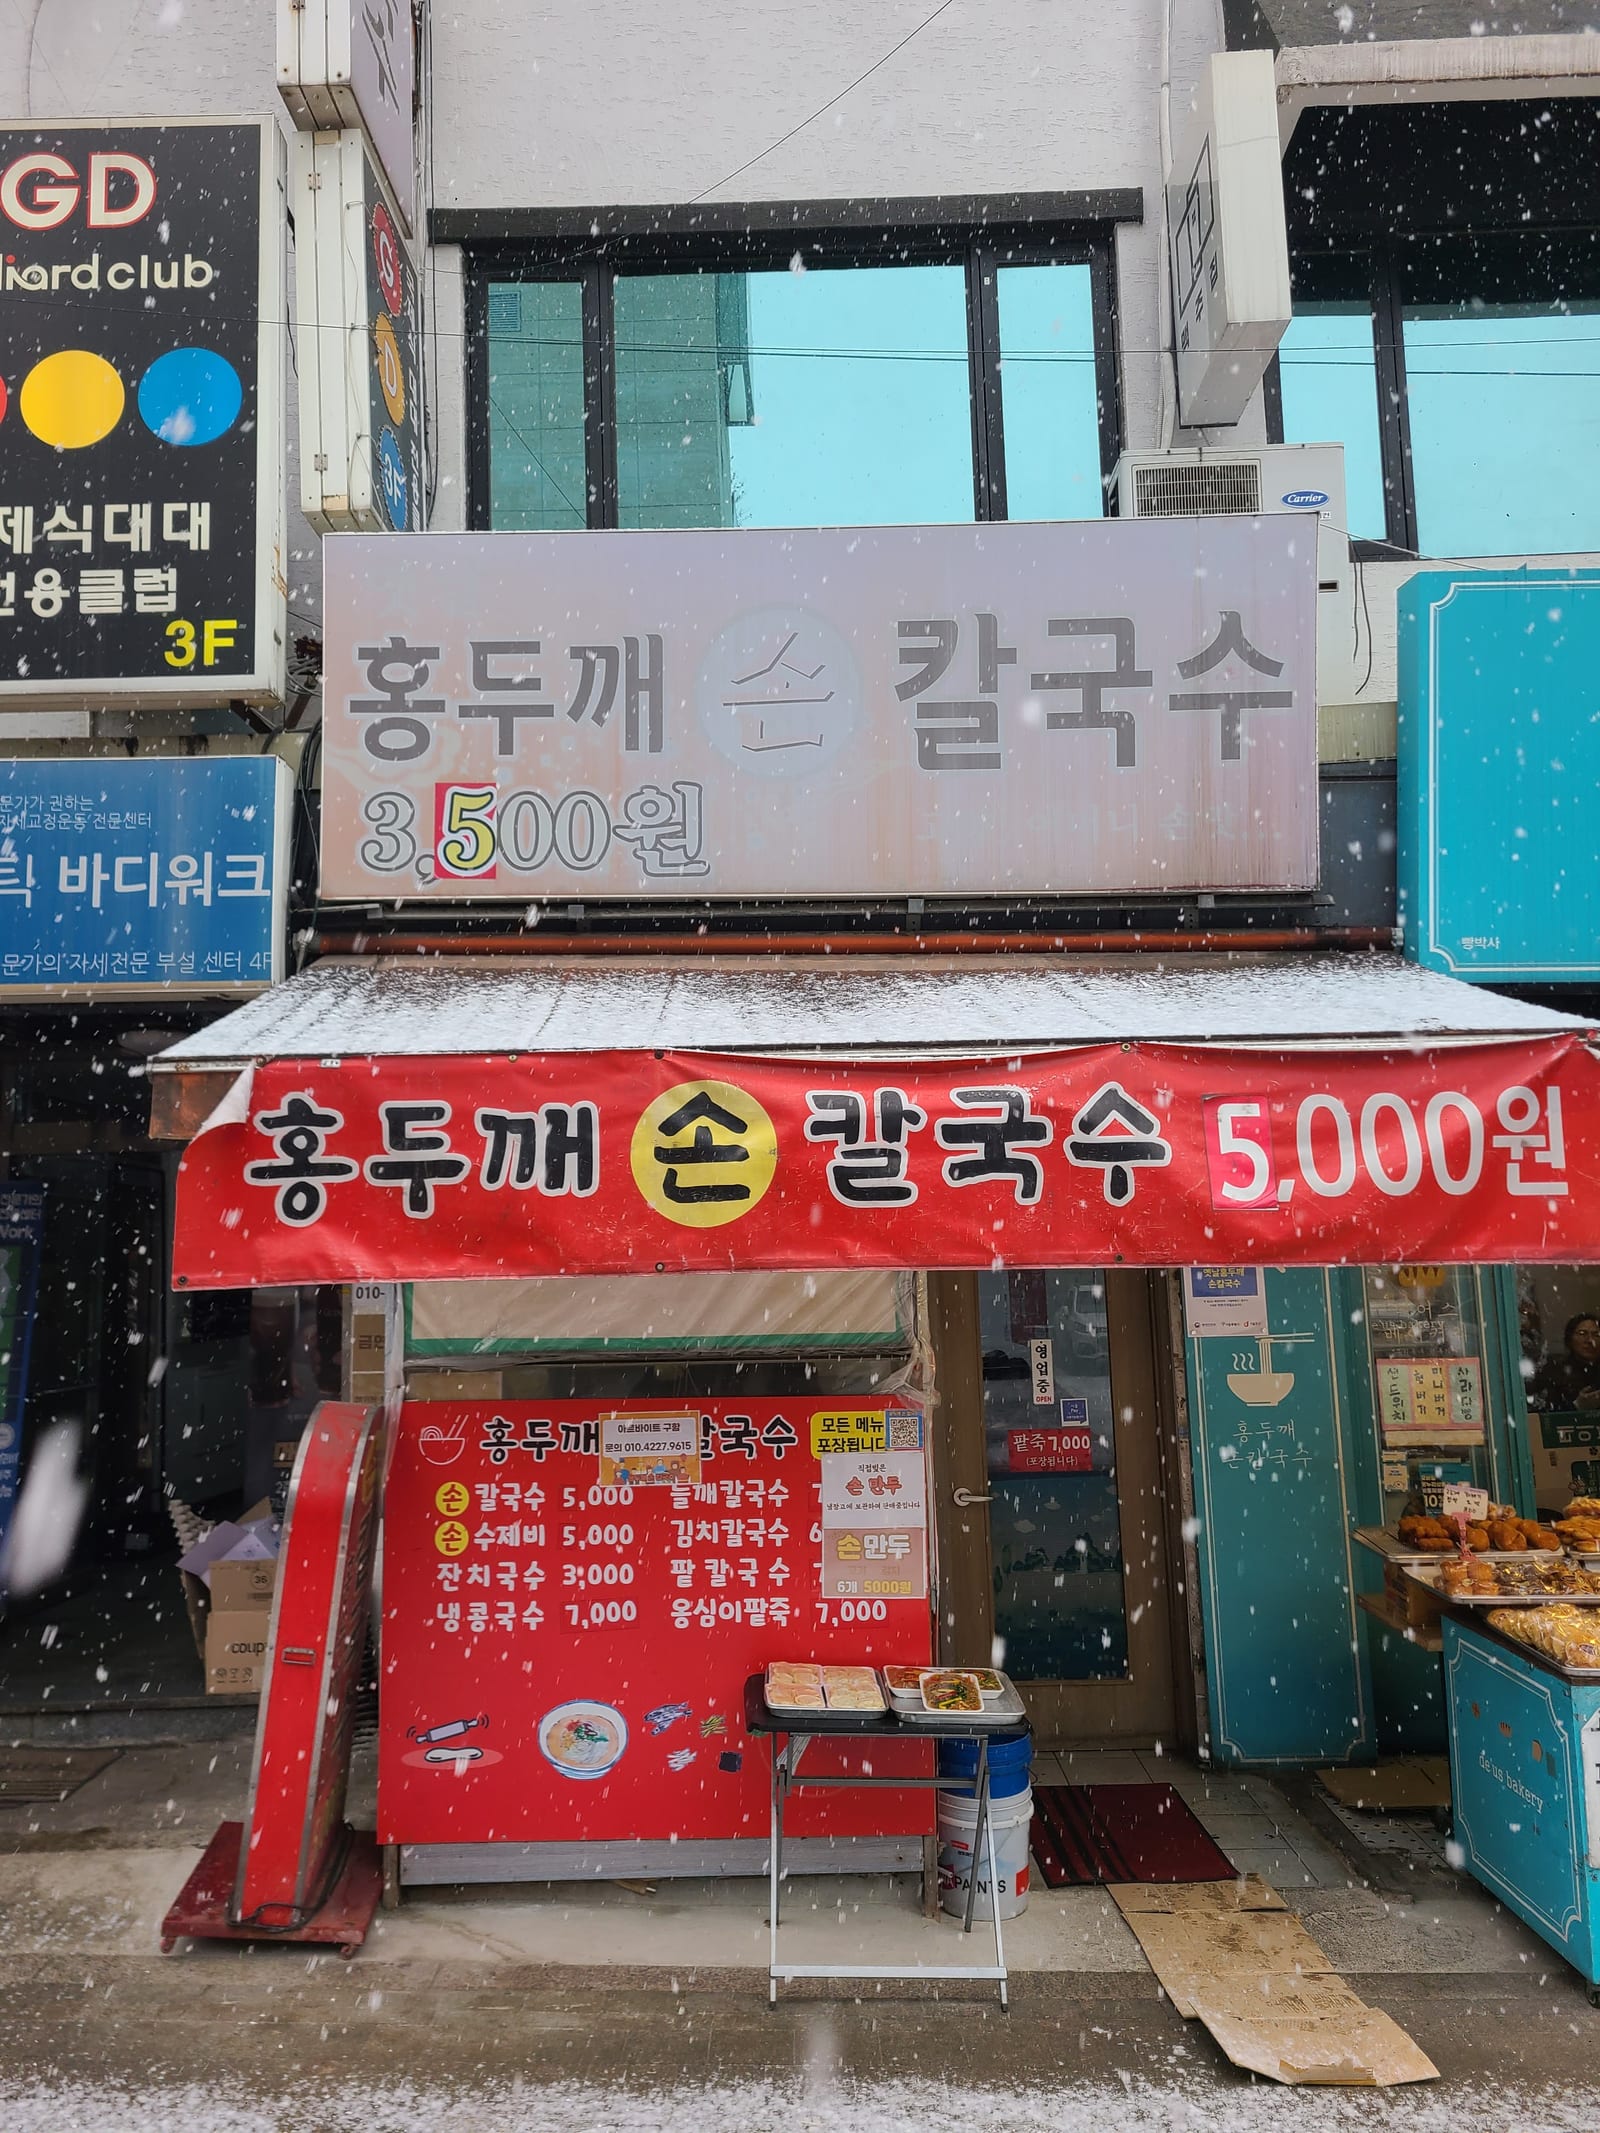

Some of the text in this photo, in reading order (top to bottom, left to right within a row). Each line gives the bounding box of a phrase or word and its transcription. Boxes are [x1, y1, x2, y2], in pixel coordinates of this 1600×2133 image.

[0, 151, 157, 230] GD
[107, 254, 213, 290] club
[1287, 494, 1324, 503] Carrier
[164, 619, 237, 667] 3F
[349, 635, 664, 761] 홍두깨
[895, 610, 1293, 770] 칼국수
[49, 795, 94, 813] 권하는
[361, 781, 712, 883] 3,500원
[58, 851, 271, 908] 바디워크
[1461, 936, 1501, 950] 빵박사
[156, 951, 195, 974] 부설
[203, 951, 241, 973] 센터
[245, 1082, 1569, 1227] 홍두깨 손 칼국수 5,000원
[1036, 1343, 1051, 1394] 영업중
[480, 1416, 599, 1464] 홍두깨
[617, 1422, 681, 1434] 아르바이트 구함
[821, 1416, 885, 1433] 모든 메뉴
[1232, 1419, 1296, 1445] 홍두깨
[605, 1441, 692, 1453] 문의 010.4227.9615
[1013, 1433, 1090, 1453] 팥죽 7,000
[442, 1482, 634, 1513] 손 칼국수 5,000
[442, 1522, 634, 1554] 손 수제비 5,000
[670, 1517, 789, 1548] 김치칼국수
[836, 1533, 911, 1561] 손만두
[436, 1561, 546, 1592] 잔치국수
[836, 1580, 912, 1595] 6개 5000원
[436, 1600, 638, 1633] 냉콩국수 7,000
[670, 1597, 887, 1628] 옹심이팥죽 7,000
[231, 1641, 267, 1656] coup
[1506, 1770, 1544, 1816] bakery
